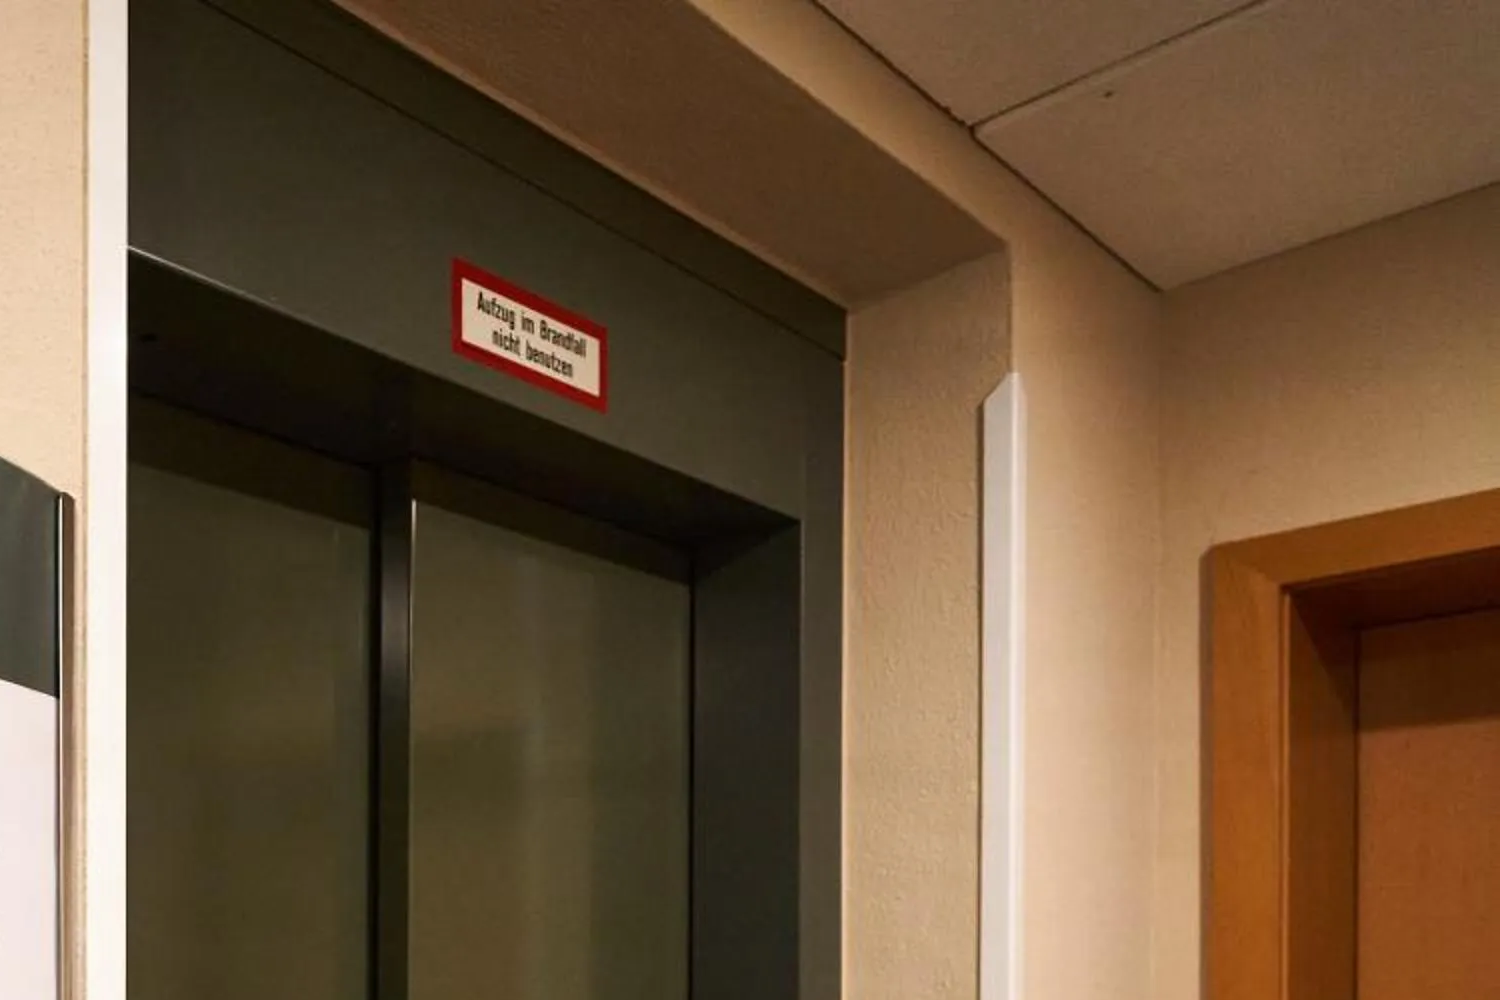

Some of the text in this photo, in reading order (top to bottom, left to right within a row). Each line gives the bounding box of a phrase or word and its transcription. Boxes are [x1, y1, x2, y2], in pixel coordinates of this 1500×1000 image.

[477, 291, 587, 358] Aufzug im Brandfall
[492, 328, 573, 378] nicht benutzen
